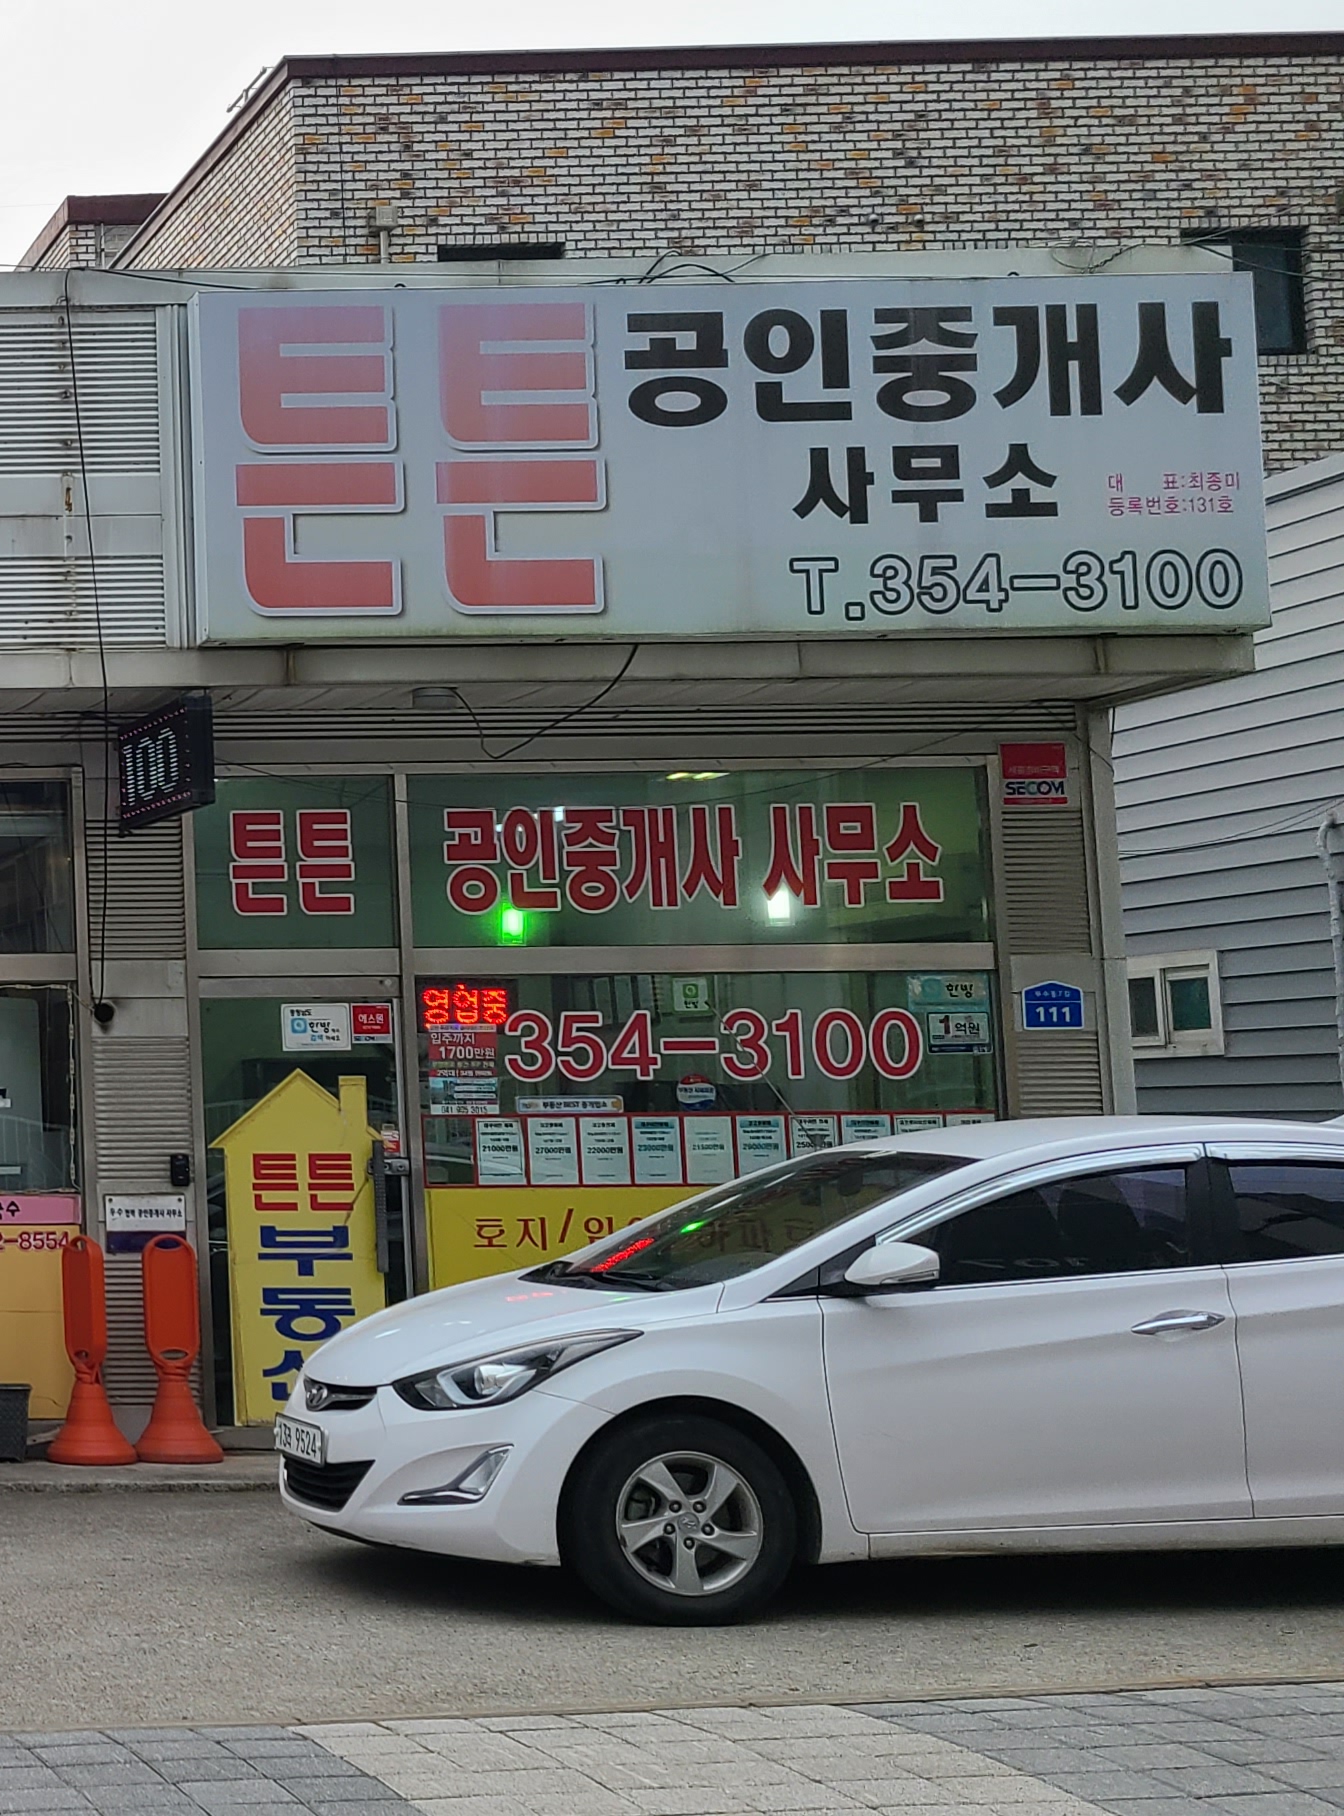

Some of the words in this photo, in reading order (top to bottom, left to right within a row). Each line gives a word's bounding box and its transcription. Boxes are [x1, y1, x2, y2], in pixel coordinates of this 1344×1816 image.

[624, 301, 1232, 427] 공인중개사
[235, 303, 609, 616] 튼튼
[792, 443, 1060, 525] 사무소
[1108, 473, 1123, 492] 대
[1108, 495, 1234, 516] 등록번호:131호
[789, 549, 1243, 621] T.354-3100
[121, 727, 179, 806] 100
[1005, 780, 1065, 796] SECOM
[229, 808, 356, 917] 튼튼
[444, 804, 740, 915] 공인중개사
[764, 802, 945, 907] 사무소
[358, 1014, 384, 1024] 에스원
[422, 984, 508, 1024] 영업중
[1035, 1006, 1071, 1022] 111
[430, 1033, 475, 1045] 입주까지
[439, 1046, 495, 1059] 1700만원
[504, 1008, 924, 1082] 354-3100
[252, 1153, 354, 1211] 튼튼
[295, 1427, 317, 1458] 9524
